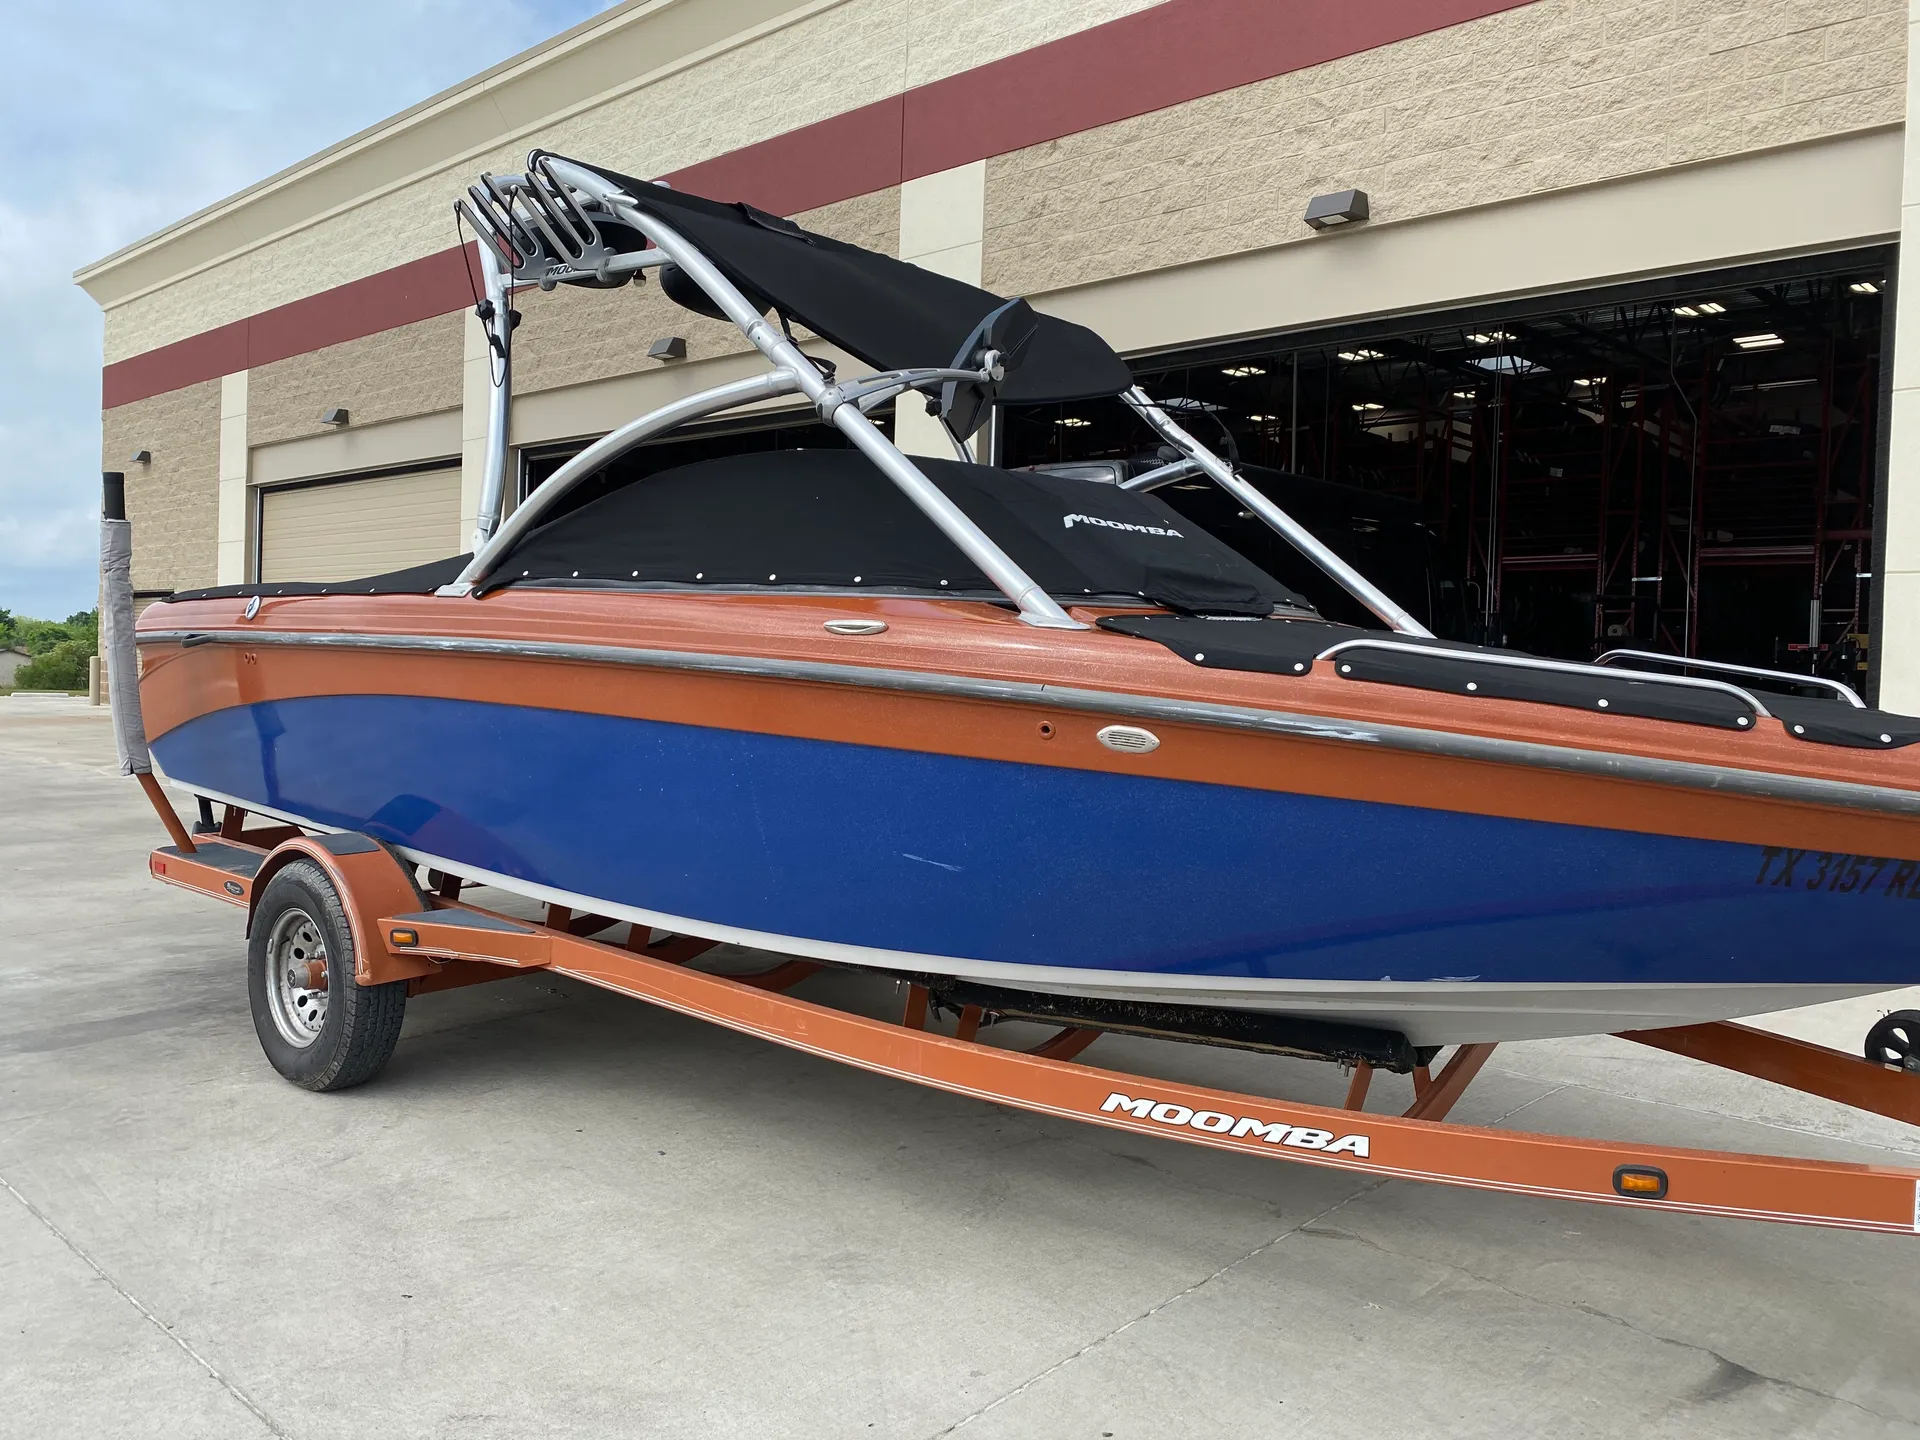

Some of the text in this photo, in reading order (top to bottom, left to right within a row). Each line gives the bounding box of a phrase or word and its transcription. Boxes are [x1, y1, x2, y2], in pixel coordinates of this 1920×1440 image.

[546, 264, 576, 277] MOO
[1063, 513, 1184, 538] MOOMBA
[1756, 847, 1806, 887] TX
[1806, 852, 1888, 894] 3157
[1099, 1092, 1370, 1158] MOOMBA
